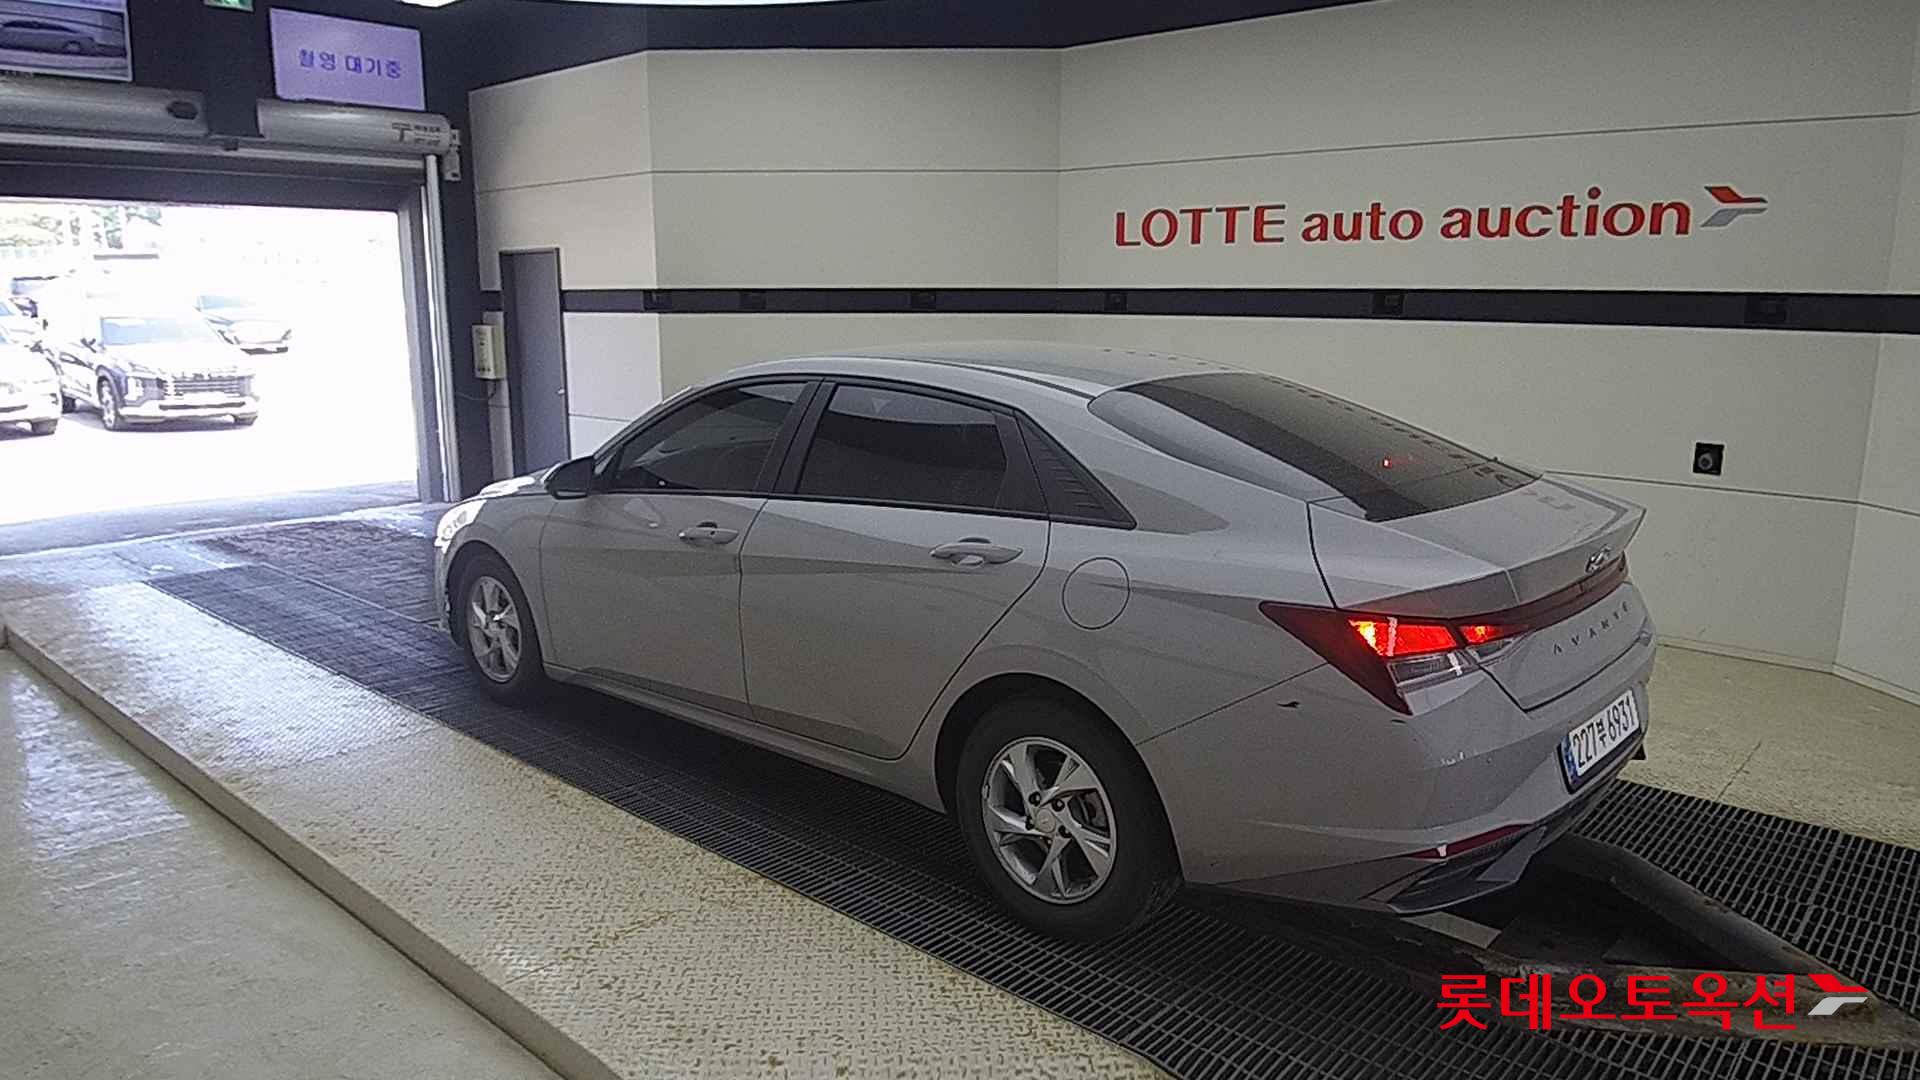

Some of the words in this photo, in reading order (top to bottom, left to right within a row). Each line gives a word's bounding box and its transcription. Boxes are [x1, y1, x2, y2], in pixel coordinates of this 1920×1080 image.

[299, 48, 336, 71] 촬영
[345, 55, 402, 79] 대기중
[1114, 203, 1286, 247] LOTTE
[1301, 201, 1423, 243] auto
[1440, 186, 1691, 239] auction
